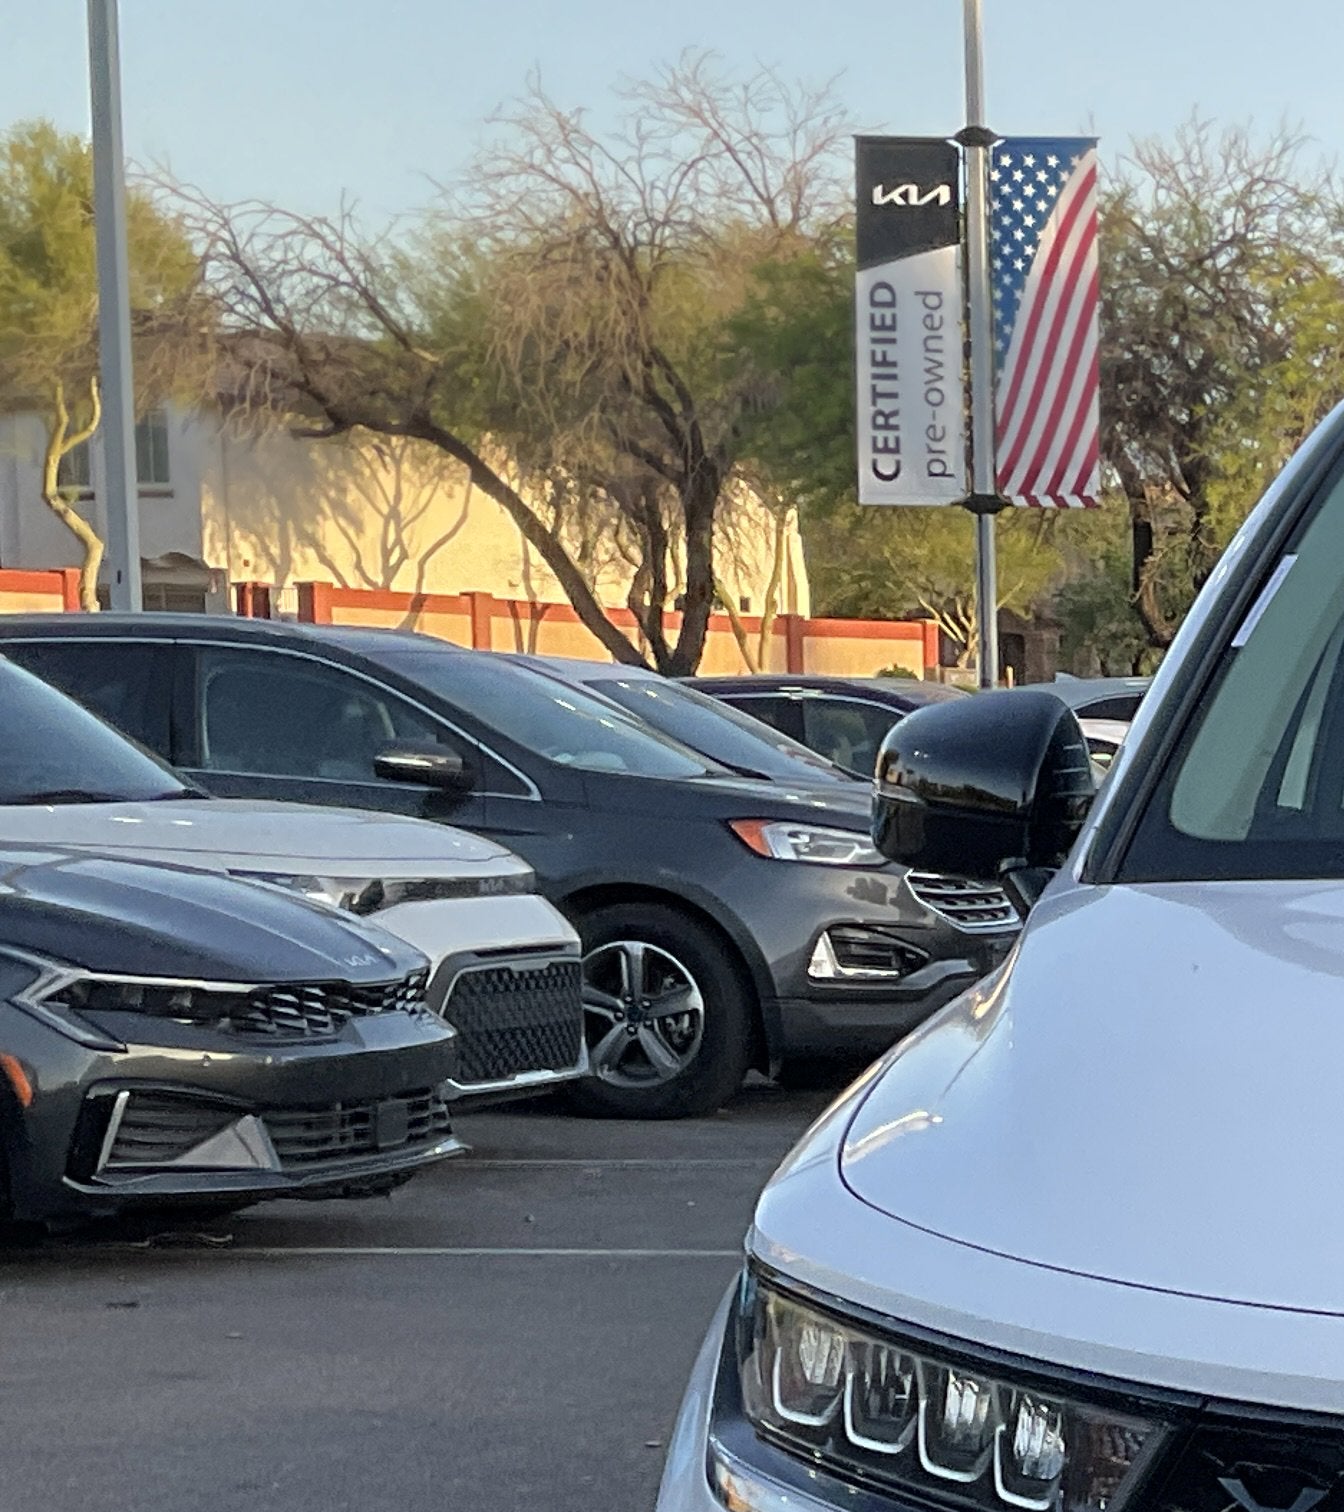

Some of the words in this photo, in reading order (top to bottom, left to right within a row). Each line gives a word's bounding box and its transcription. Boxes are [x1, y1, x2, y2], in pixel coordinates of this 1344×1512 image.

[872, 184, 951, 206] KIA
[869, 281, 901, 482] CERTIFIED
[914, 290, 955, 479] pre-owned
